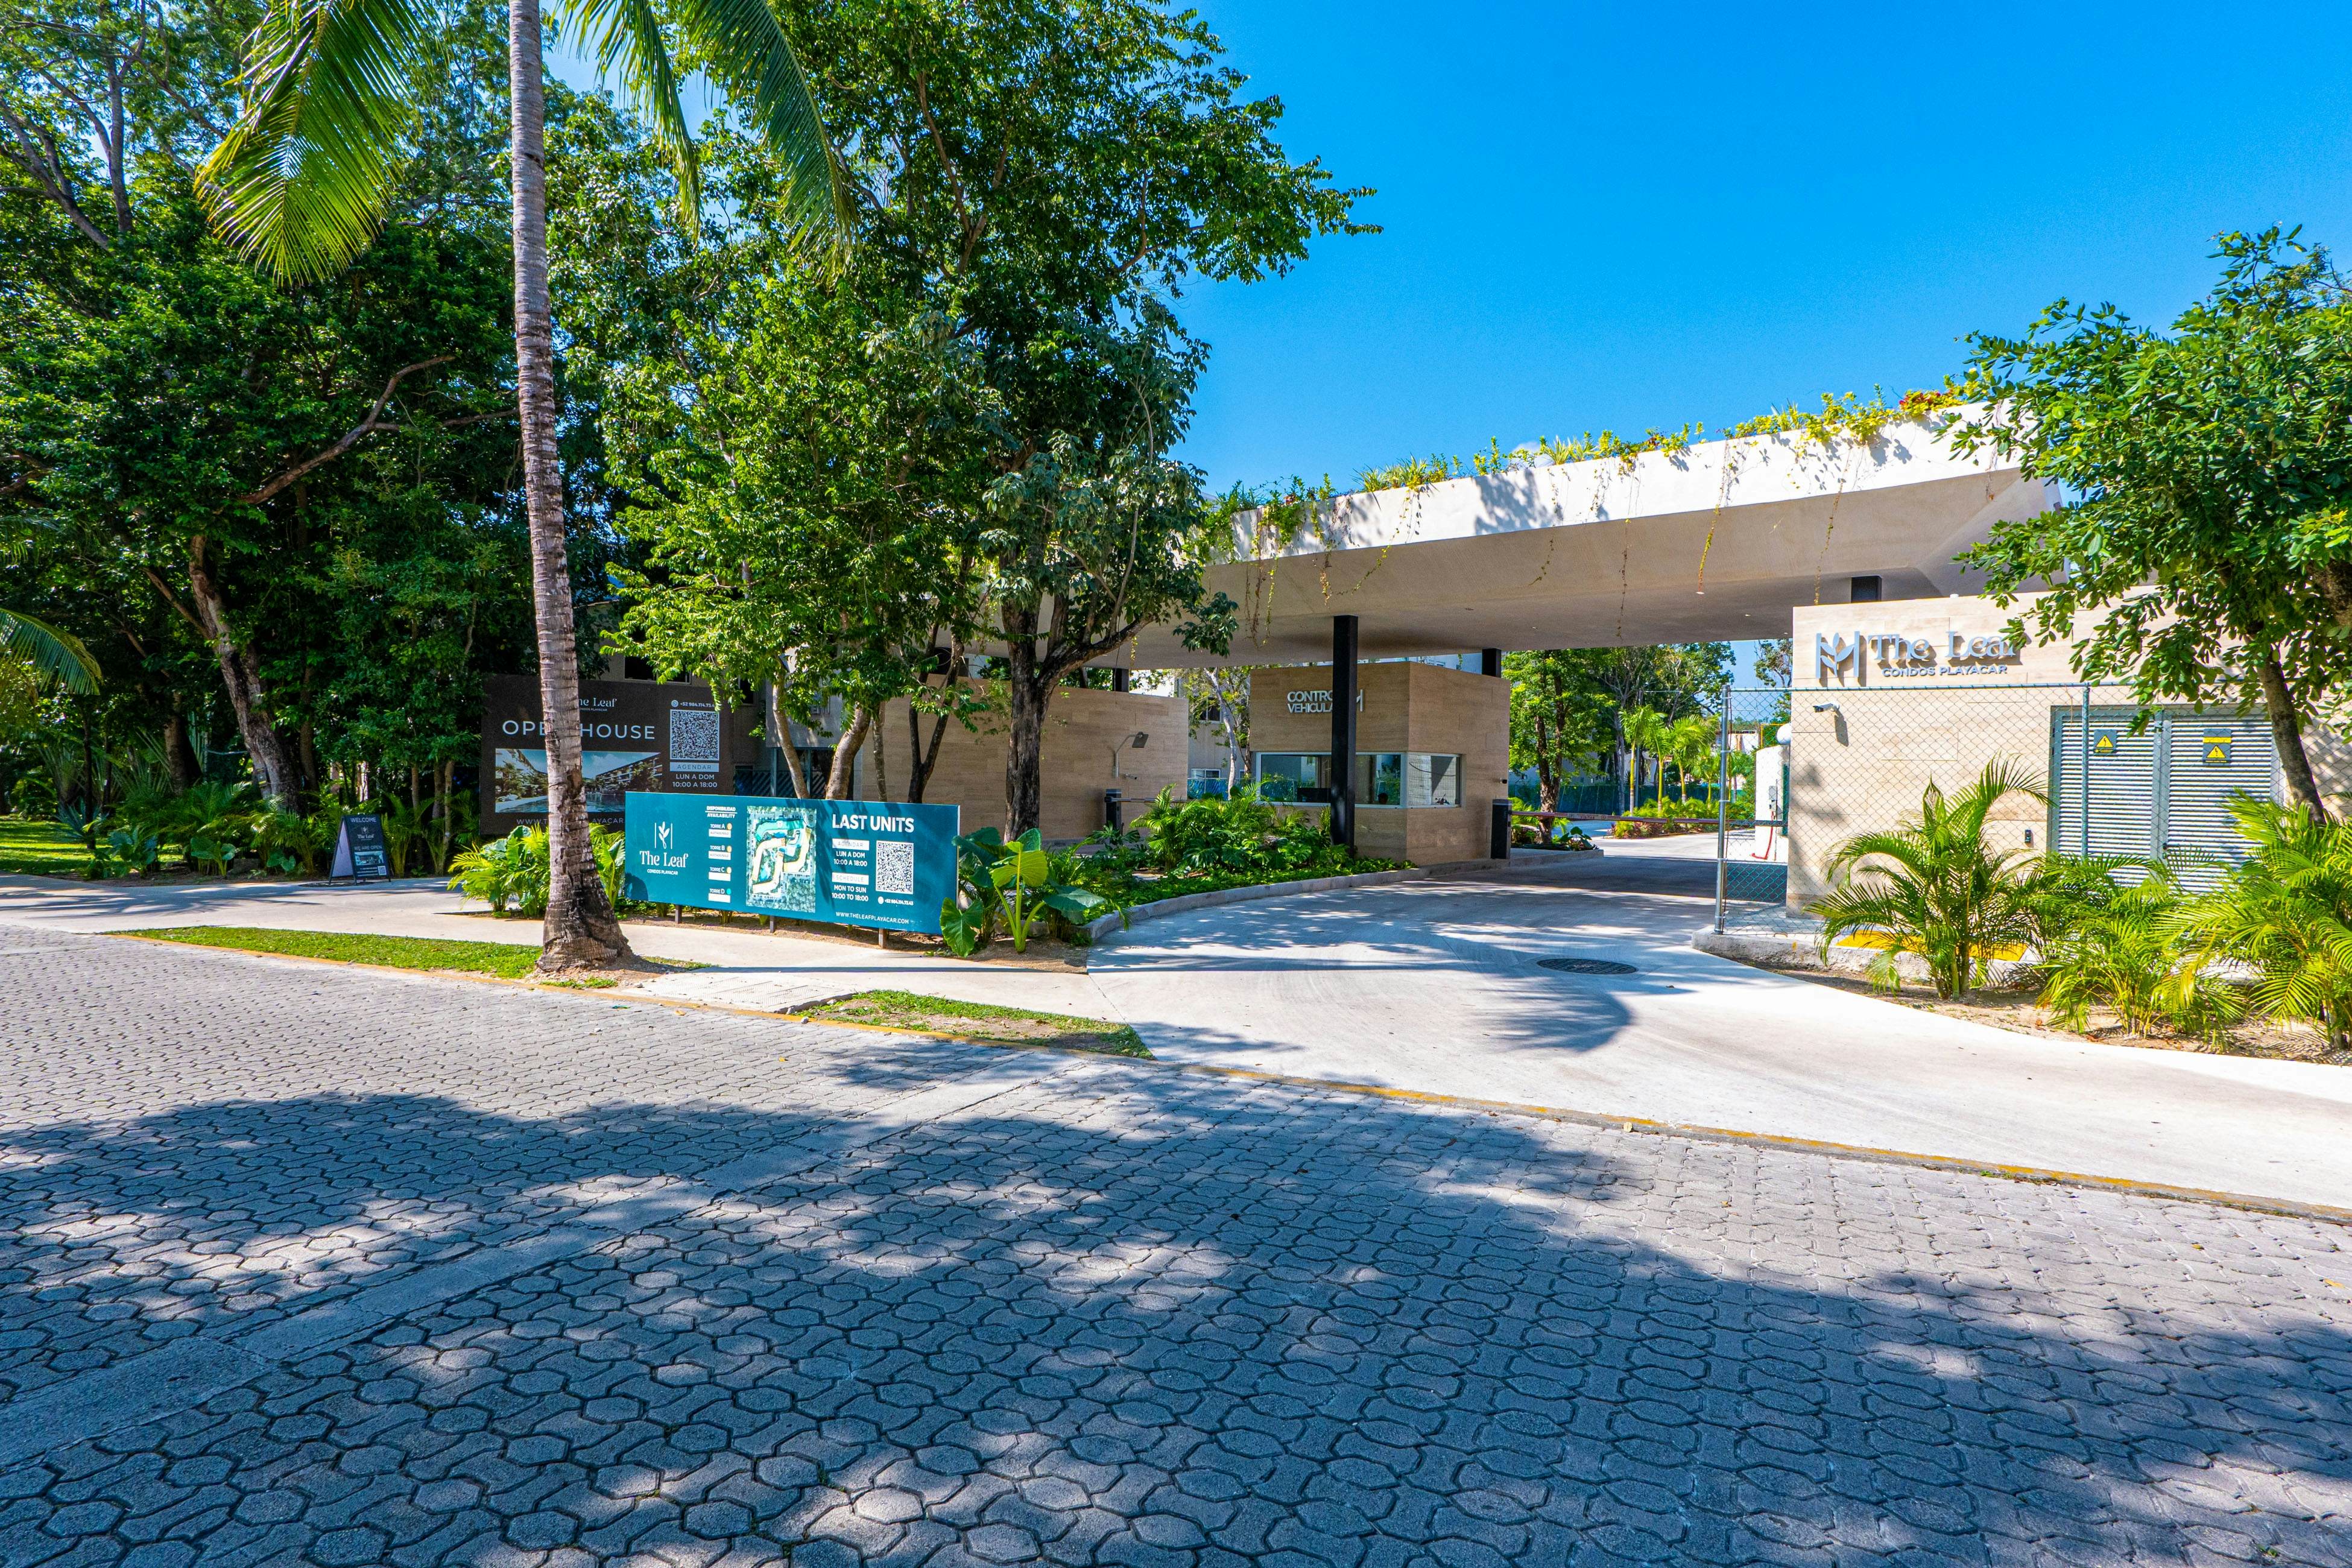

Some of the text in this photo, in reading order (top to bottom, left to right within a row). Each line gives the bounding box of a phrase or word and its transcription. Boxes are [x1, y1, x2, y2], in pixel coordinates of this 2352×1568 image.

[1868, 634, 1930, 660] The
[1882, 665, 2008, 677] CONDOS PLAYACAR
[593, 698, 618, 707] Leaf
[1287, 690, 1332, 702] CONTRO
[1287, 703, 1332, 713] VEHICUL
[502, 720, 655, 739] OPE HOUSE
[832, 814, 914, 833] LAST UNITS
[639, 850, 689, 868] The Leaf
[836, 911, 909, 924] WWW.THELEAFPLAYACAR.COM
